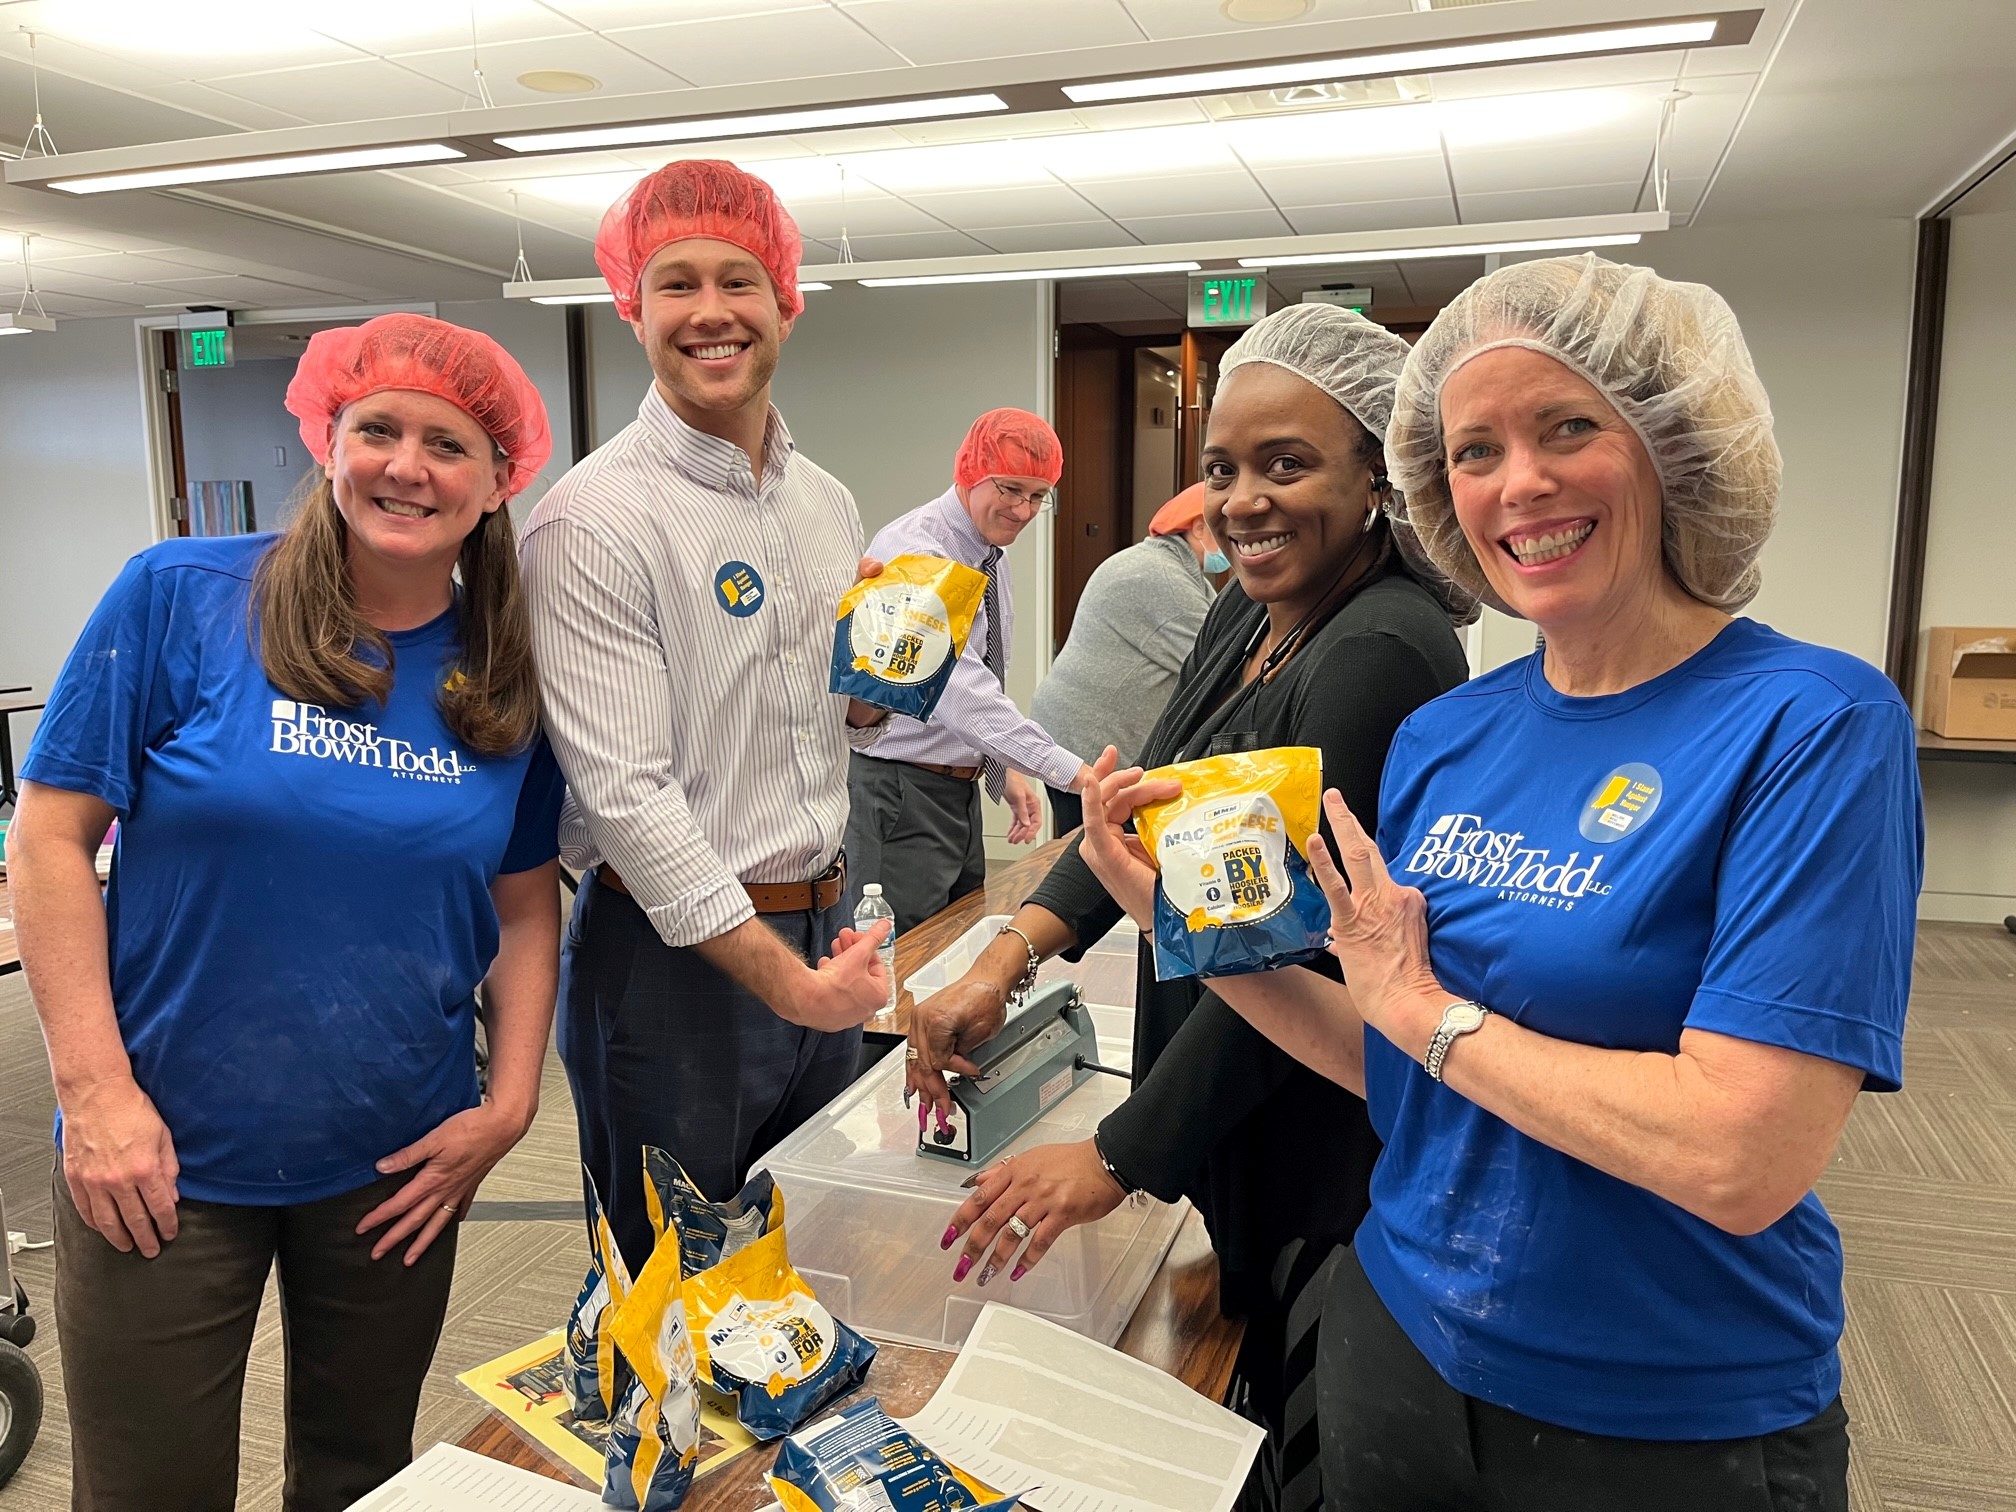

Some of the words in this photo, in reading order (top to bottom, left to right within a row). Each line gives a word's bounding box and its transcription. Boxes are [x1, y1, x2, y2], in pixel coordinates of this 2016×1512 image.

[1204, 279, 1256, 322] EXIT
[191, 330, 226, 366] EXIT
[894, 639, 922, 660] BY
[900, 634, 924, 646] ACKED
[889, 658, 916, 674] FOR
[297, 702, 379, 747] Frost
[269, 720, 383, 768] Brown
[379, 737, 461, 776] Todd
[392, 771, 461, 785] ATTORNEYS
[1164, 827, 1204, 848] MAC
[1213, 813, 1279, 834] CHEESE
[1440, 814, 1524, 861] Frost
[1223, 847, 1261, 860] PACKED
[1224, 855, 1262, 883] BY
[1405, 836, 1509, 887] Brown
[1501, 849, 1604, 898] Todd
[1586, 880, 1612, 896] LLC
[1230, 876, 1269, 890] HOOSIERS
[1231, 883, 1271, 904] FOR
[1498, 889, 1575, 912] ATTORNEYS
[791, 1327, 818, 1347] HOOSIERS
[794, 1333, 824, 1359] FOR
